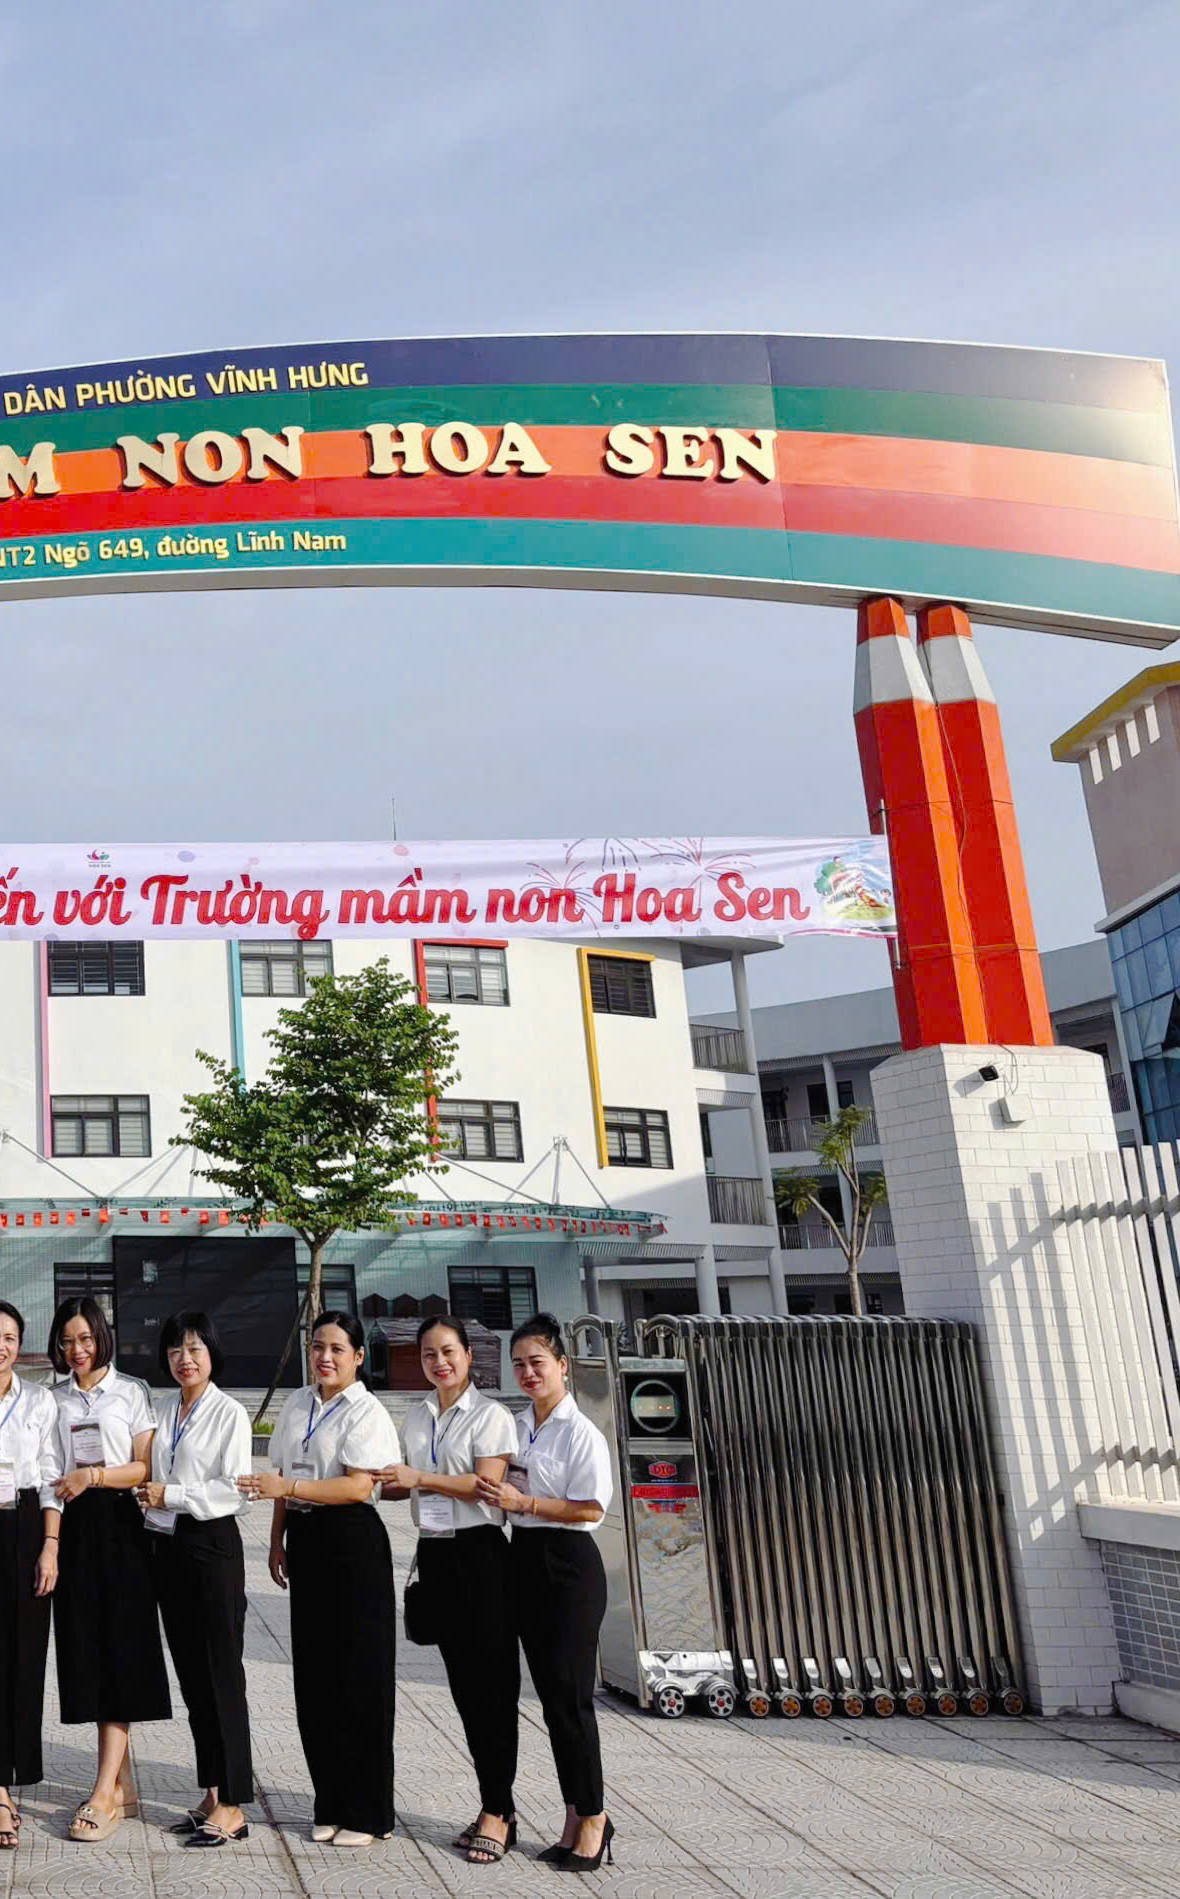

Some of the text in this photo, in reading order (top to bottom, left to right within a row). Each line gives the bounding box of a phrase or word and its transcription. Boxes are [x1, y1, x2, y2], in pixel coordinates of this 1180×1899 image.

[3, 383, 67, 415] DÂN
[75, 370, 197, 407] PHƯỜNG
[205, 365, 278, 395] VĨNH
[287, 362, 369, 389] HƯNG
[117, 426, 306, 488] NON
[365, 421, 552, 475] HOA
[605, 423, 778, 484] SEN
[44, 543, 91, 569] Ngõ
[99, 539, 150, 561] 649,
[157, 536, 230, 560] đường
[237, 531, 285, 552] Lĩnh
[293, 532, 347, 551] Nam
[53, 872, 132, 927] với
[140, 873, 330, 941] Trường
[338, 867, 477, 925] mầm
[485, 888, 584, 924] non
[593, 872, 701, 924] Hoa
[714, 871, 810, 923] Sen
